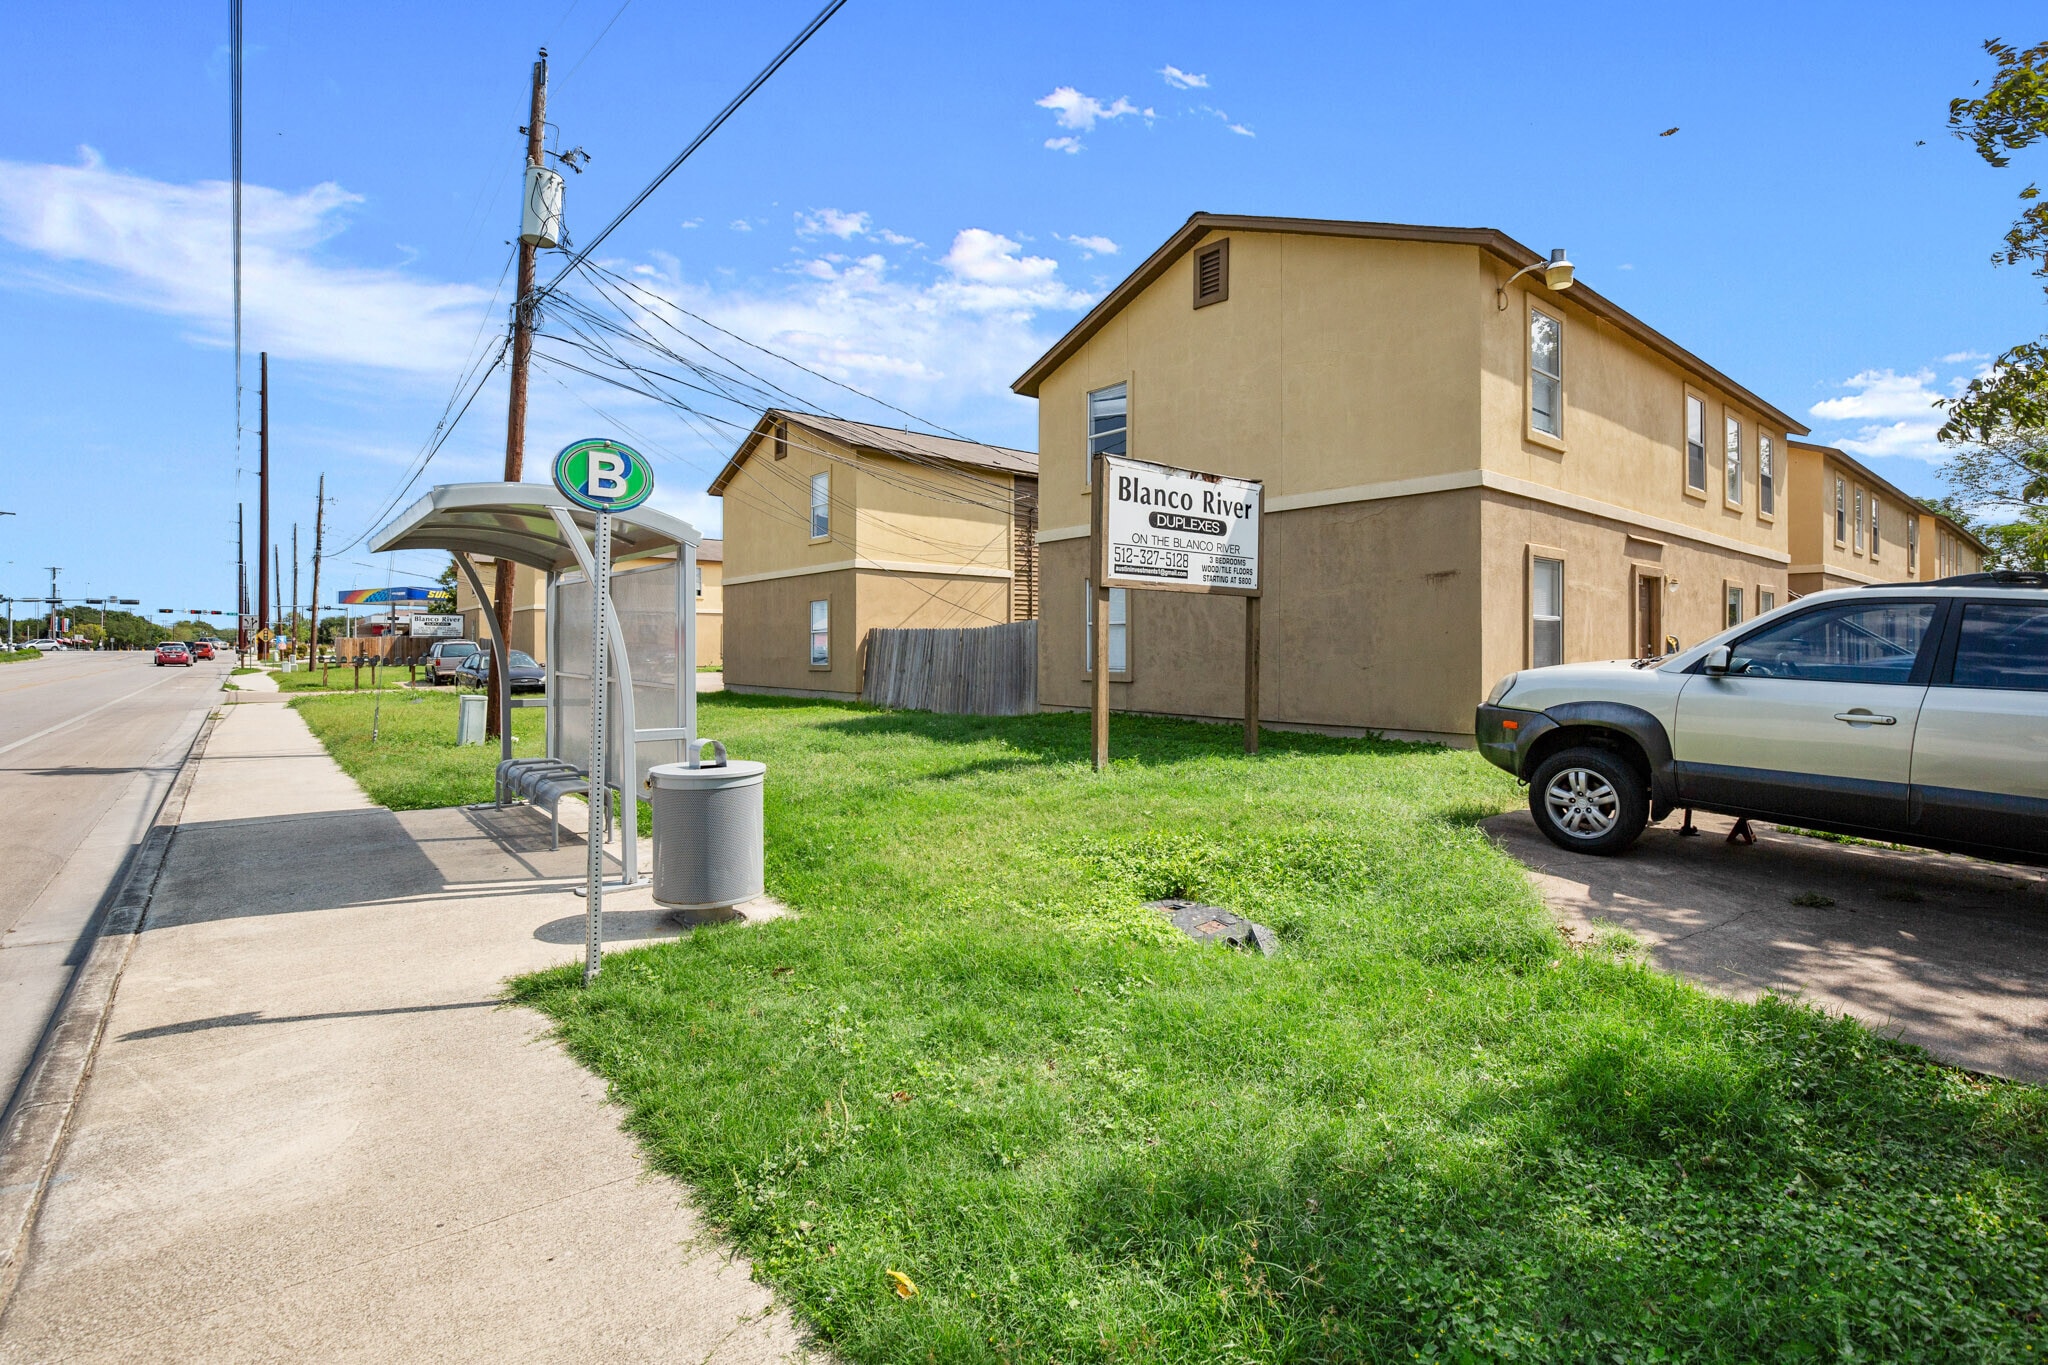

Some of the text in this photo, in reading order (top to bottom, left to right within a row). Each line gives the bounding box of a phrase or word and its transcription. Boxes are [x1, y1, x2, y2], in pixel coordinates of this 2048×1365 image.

[588, 451, 627, 498] B
[1118, 475, 1252, 520] Blanco River
[1156, 514, 1220, 534] DUPLEXES
[1131, 532, 1241, 555] ON THE BLANCO RIVER
[1114, 546, 1189, 568] 512-327-5128
[1209, 556, 1246, 566] 3 BEDROOMS
[1201, 564, 1254, 576] WOOD/TILE FLOORS
[1202, 574, 1229, 584] STARTING
[1230, 576, 1237, 584] AT
